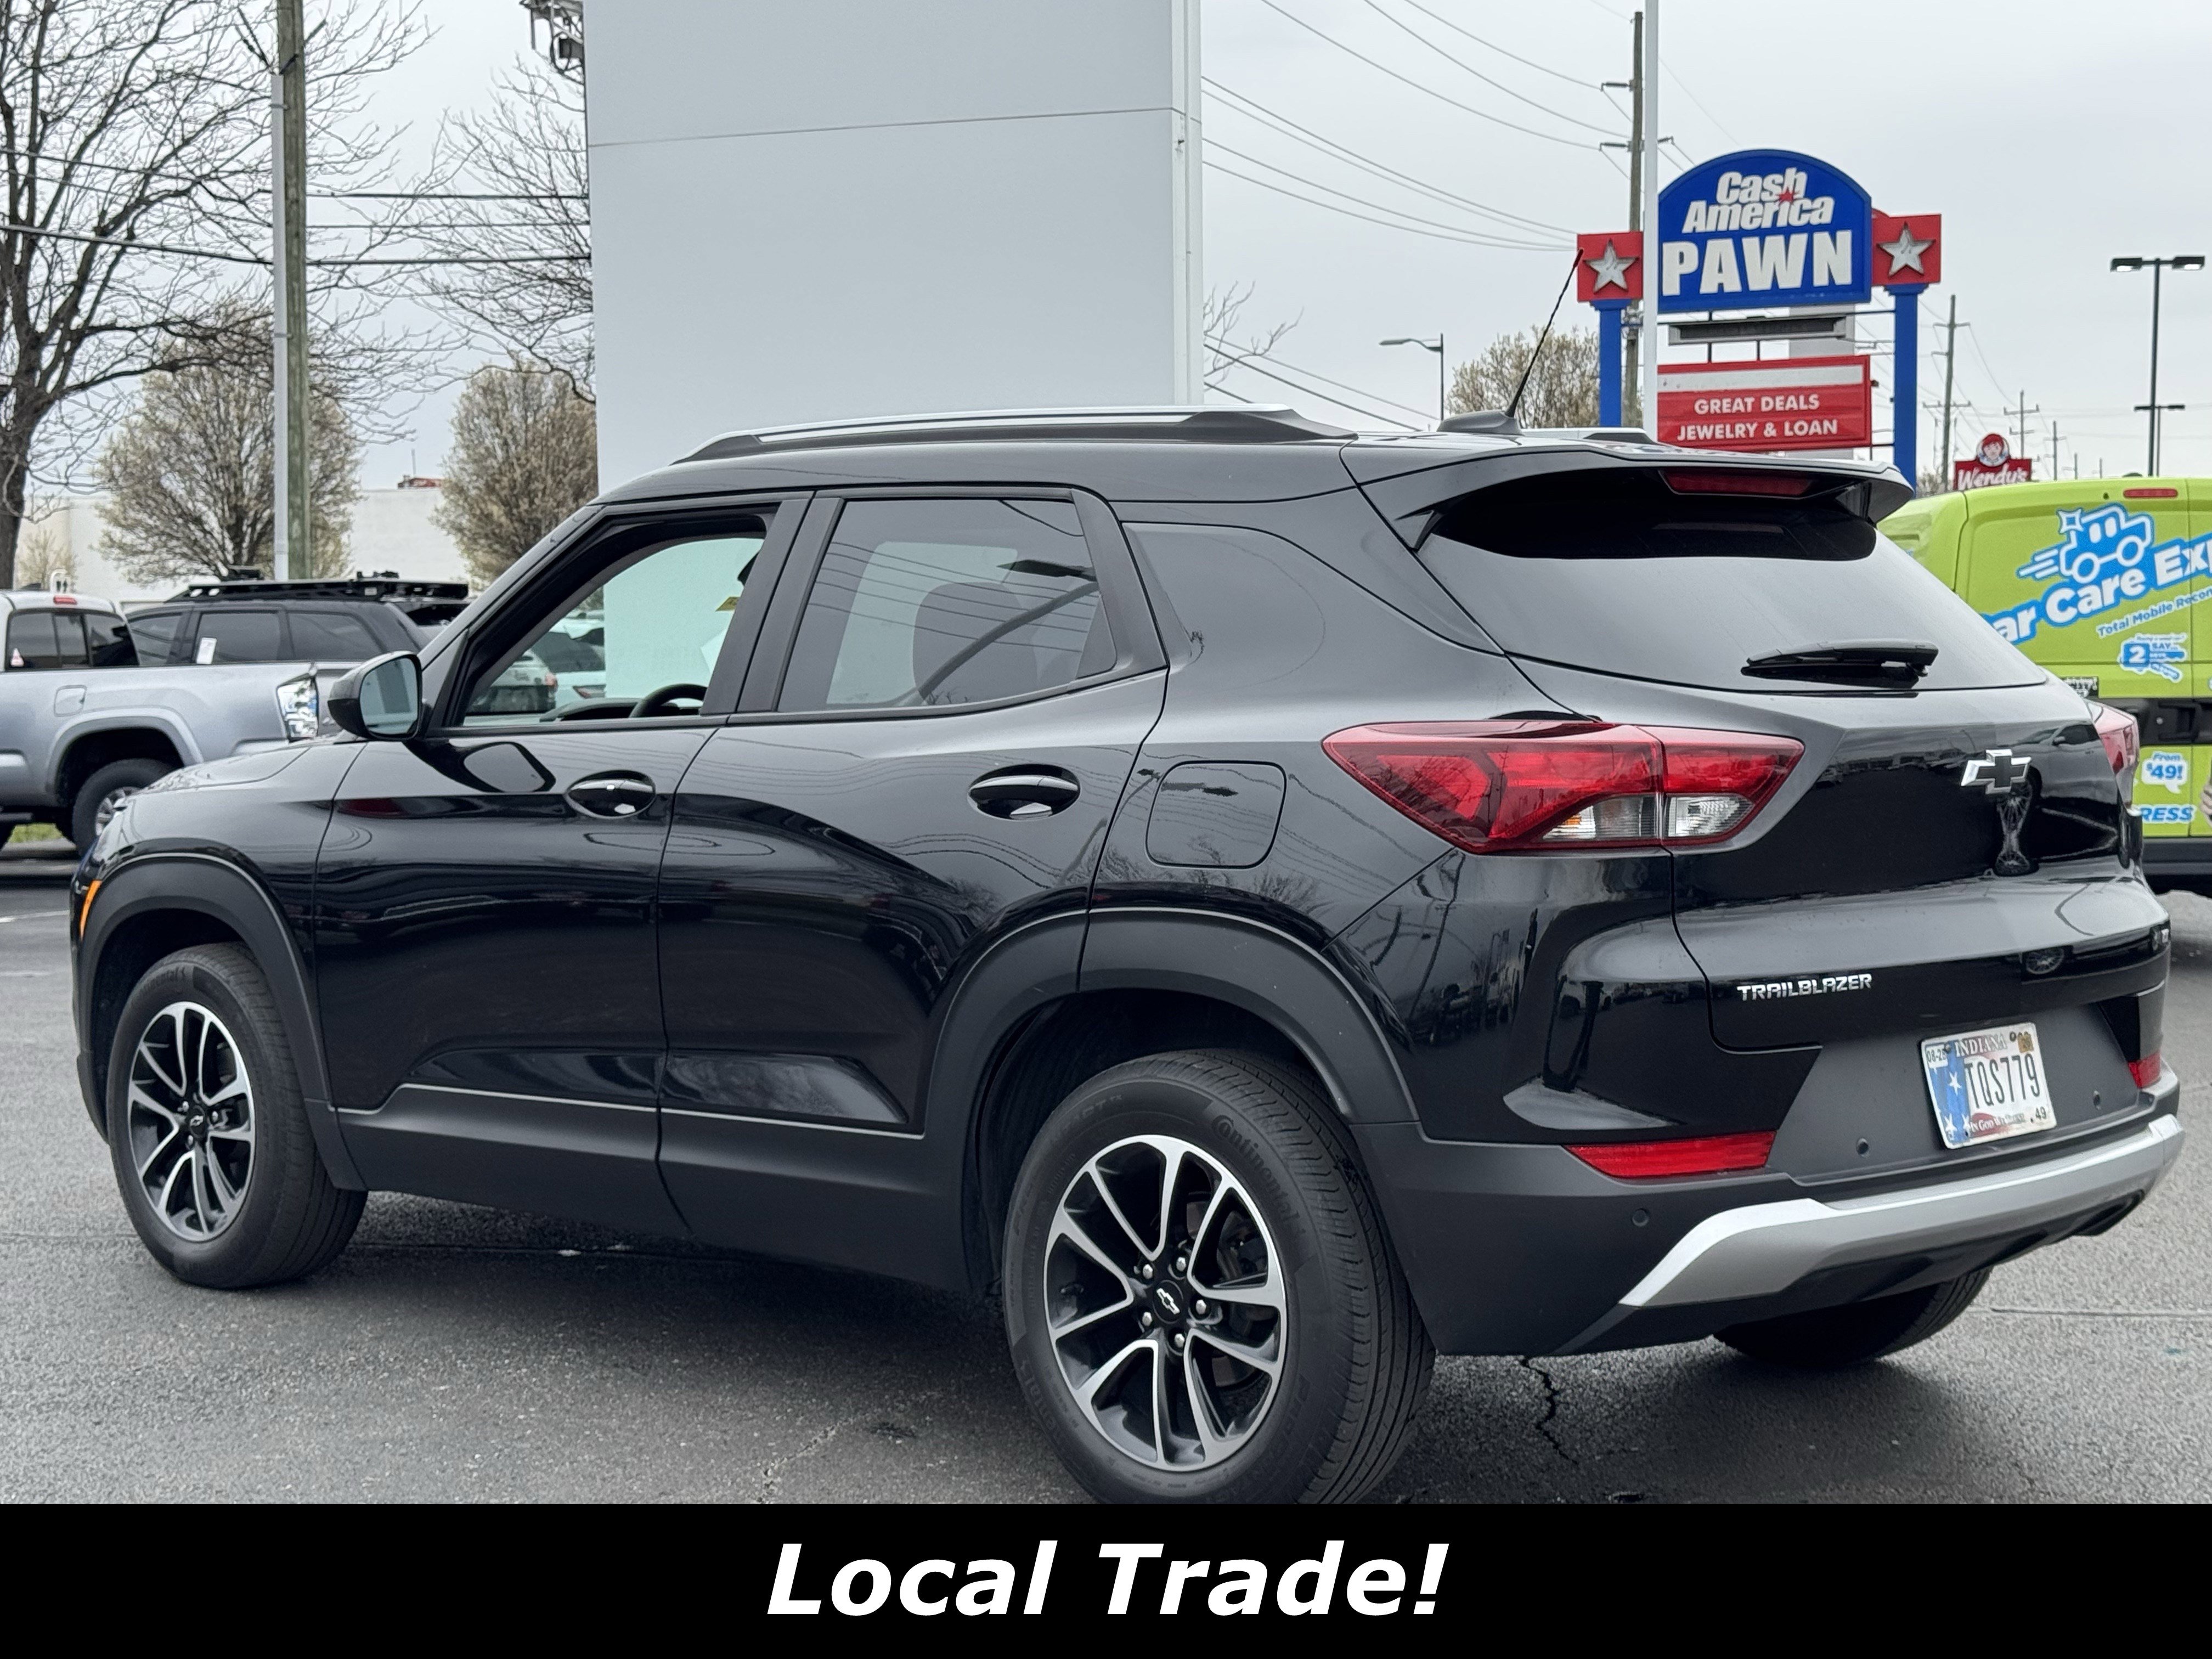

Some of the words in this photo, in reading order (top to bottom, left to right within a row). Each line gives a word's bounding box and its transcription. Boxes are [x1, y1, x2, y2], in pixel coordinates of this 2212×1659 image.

[1716, 167, 1808, 204] Cash
[1681, 196, 1835, 234] America
[1662, 229, 1853, 296] PAWN
[1694, 397, 1755, 415] GREAT
[1760, 394, 1820, 412] DEALS
[1677, 422, 1757, 441] JEWELRY
[1763, 422, 1777, 438] &
[1784, 419, 1838, 437] LOAN
[2045, 568, 2146, 623] Care
[2098, 618, 2129, 636] Total
[2132, 603, 2172, 624] Mobile
[2129, 646, 2145, 663] 2
[1737, 973, 1872, 1001] TRAILBLAZER
[1955, 1032, 2008, 1057] INDIANA
[1964, 1053, 2040, 1109] TQS779
[2035, 1106, 2047, 1120] 49
